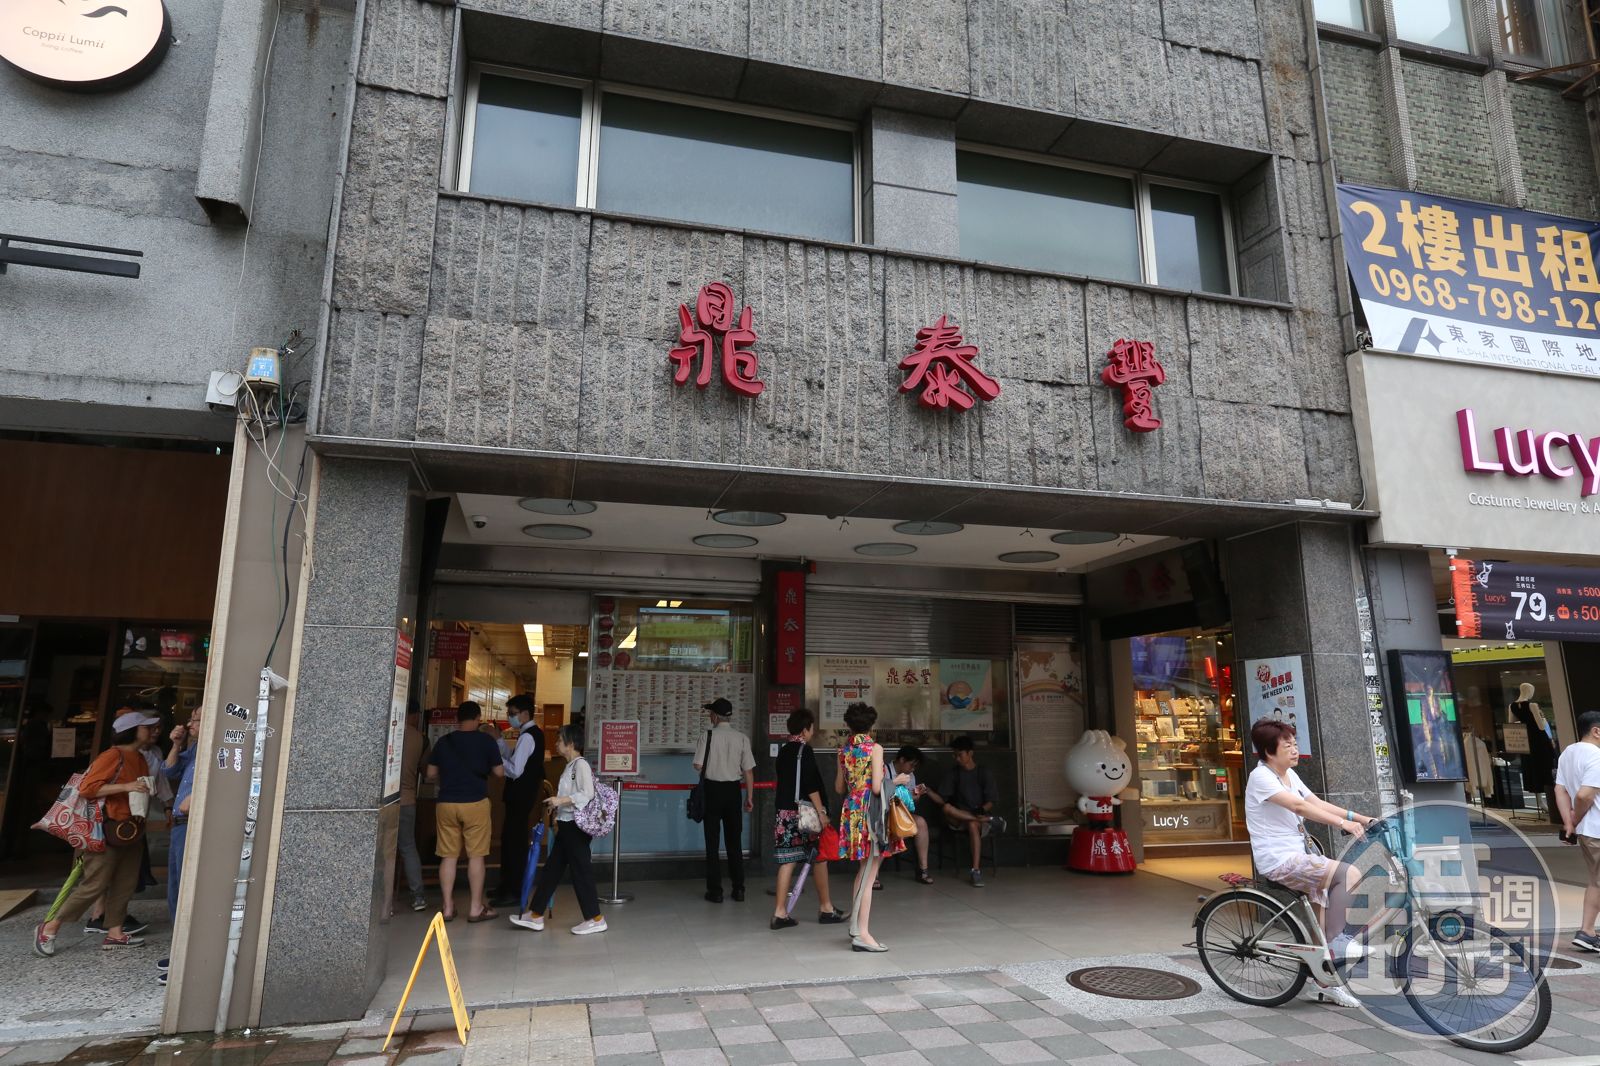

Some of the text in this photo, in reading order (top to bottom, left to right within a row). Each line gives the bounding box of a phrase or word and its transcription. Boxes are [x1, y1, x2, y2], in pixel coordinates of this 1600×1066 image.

[22, 26, 65, 42] Coppii
[69, 35, 105, 49] Lumii
[1349, 199, 1600, 295] 2樓出租
[1368, 263, 1600, 331] 0968-798-12
[1456, 346, 1490, 361] ALPHA
[1490, 353, 1570, 372] INTERNATIONAL
[1468, 492, 1521, 508] Costume
[1524, 497, 1577, 515] Jewellery
[1580, 501, 1590, 513] &
[1484, 593, 1507, 603] Lucy's
[1573, 605, 1600, 621] $50
[1262, 683, 1294, 700] WE NEED YOU
[225, 730, 246, 740] ROOTS
[1153, 814, 1189, 829] Lucy's
